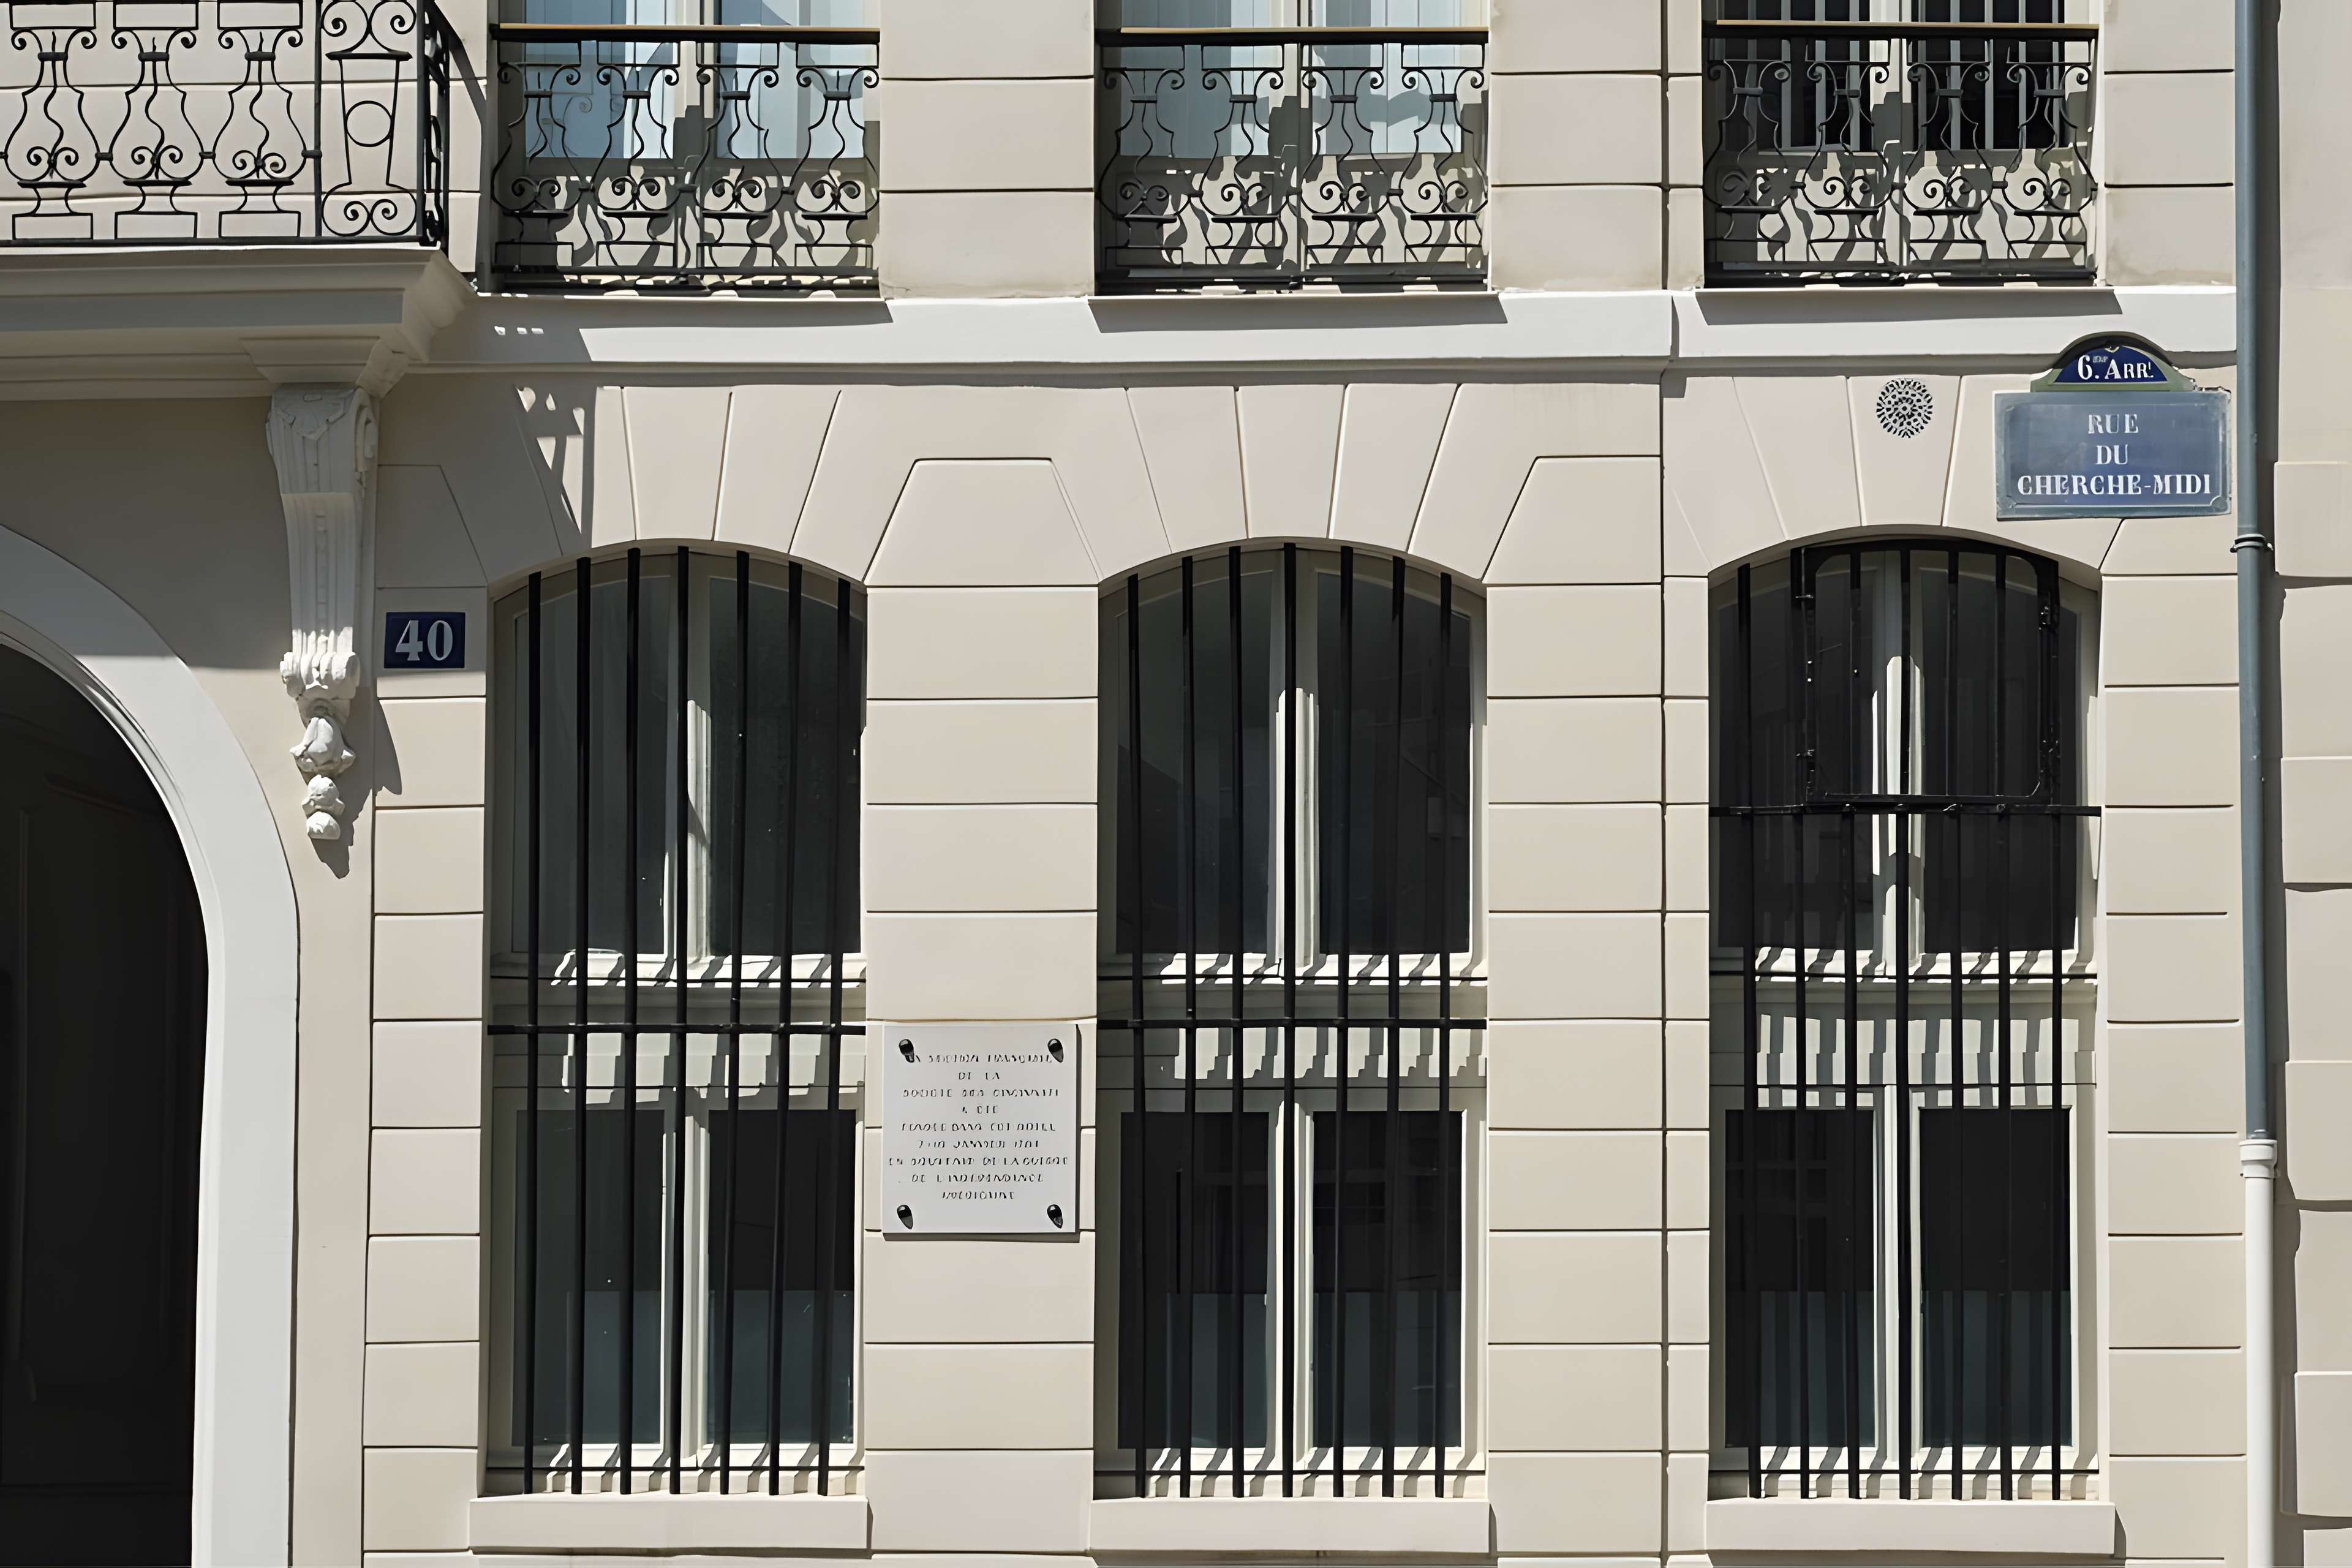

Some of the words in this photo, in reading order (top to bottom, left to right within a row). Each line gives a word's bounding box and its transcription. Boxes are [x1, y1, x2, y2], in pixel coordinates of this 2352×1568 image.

[2088, 413, 2139, 434] RUE
[2095, 444, 2129, 466] DU
[2018, 473, 2211, 496] CHERCHE-MIDI
[394, 619, 453, 662] 40
